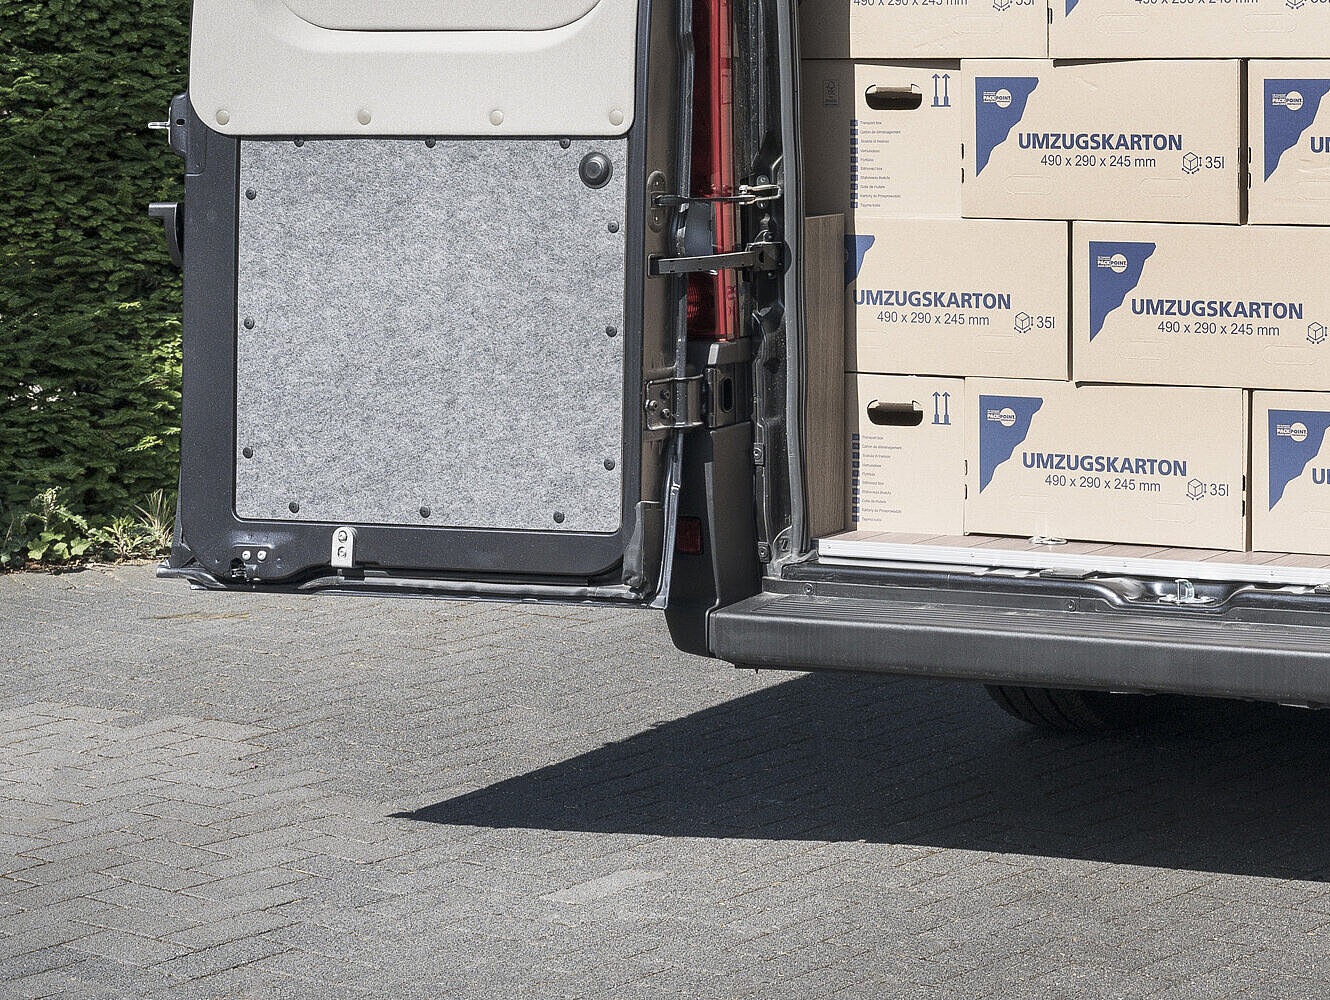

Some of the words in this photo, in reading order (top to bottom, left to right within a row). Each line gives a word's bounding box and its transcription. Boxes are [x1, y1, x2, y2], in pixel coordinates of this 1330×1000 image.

[1019, 133, 1182, 150] UMZUGSKARTON
[1041, 154, 1061, 166] 490
[1066, 158, 1071, 166] x
[1075, 155, 1096, 166] 290
[1100, 158, 1106, 166] x
[1110, 155, 1131, 167] 245
[1135, 159, 1155, 167] mm
[853, 290, 1010, 309] UMZUGSKARTON
[1132, 299, 1302, 319] UMZUGSKARTON
[877, 311, 897, 322] 490
[901, 315, 907, 323] x
[911, 312, 931, 323] 290
[935, 316, 940, 324] x
[944, 313, 965, 325] 245
[969, 317, 989, 325] mm
[1158, 321, 1180, 333] 490
[1184, 324, 1190, 333] x
[1194, 322, 1216, 334] 290
[1220, 326, 1227, 334] x
[1231, 323, 1253, 335] 245
[1258, 327, 1279, 336] mm
[1023, 452, 1186, 476] UMZUGSKARTON
[1045, 475, 1066, 486] 490
[1070, 478, 1076, 487] x
[1080, 474, 1100, 488] 290
[1104, 481, 1110, 489] x
[1114, 478, 1135, 490] 245
[1140, 483, 1160, 491] mm
